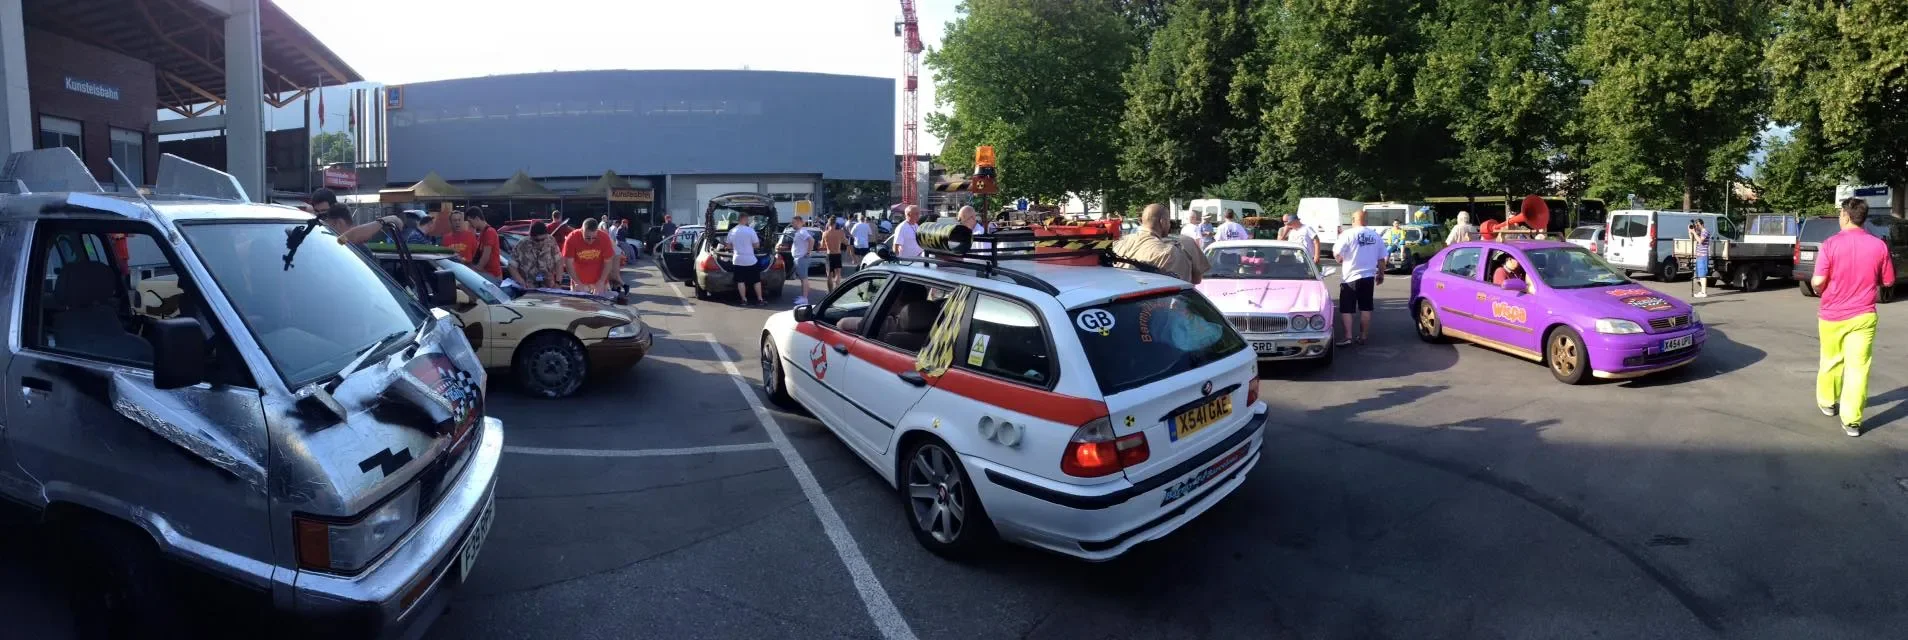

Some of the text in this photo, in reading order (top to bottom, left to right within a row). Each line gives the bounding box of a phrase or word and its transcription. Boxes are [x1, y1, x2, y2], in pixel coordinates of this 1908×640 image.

[65, 75, 119, 101] Kunsteisbahn
[1081, 311, 1112, 330] GB
[1252, 342, 1272, 351] SRD
[1180, 396, 1229, 434] X541 GAE
